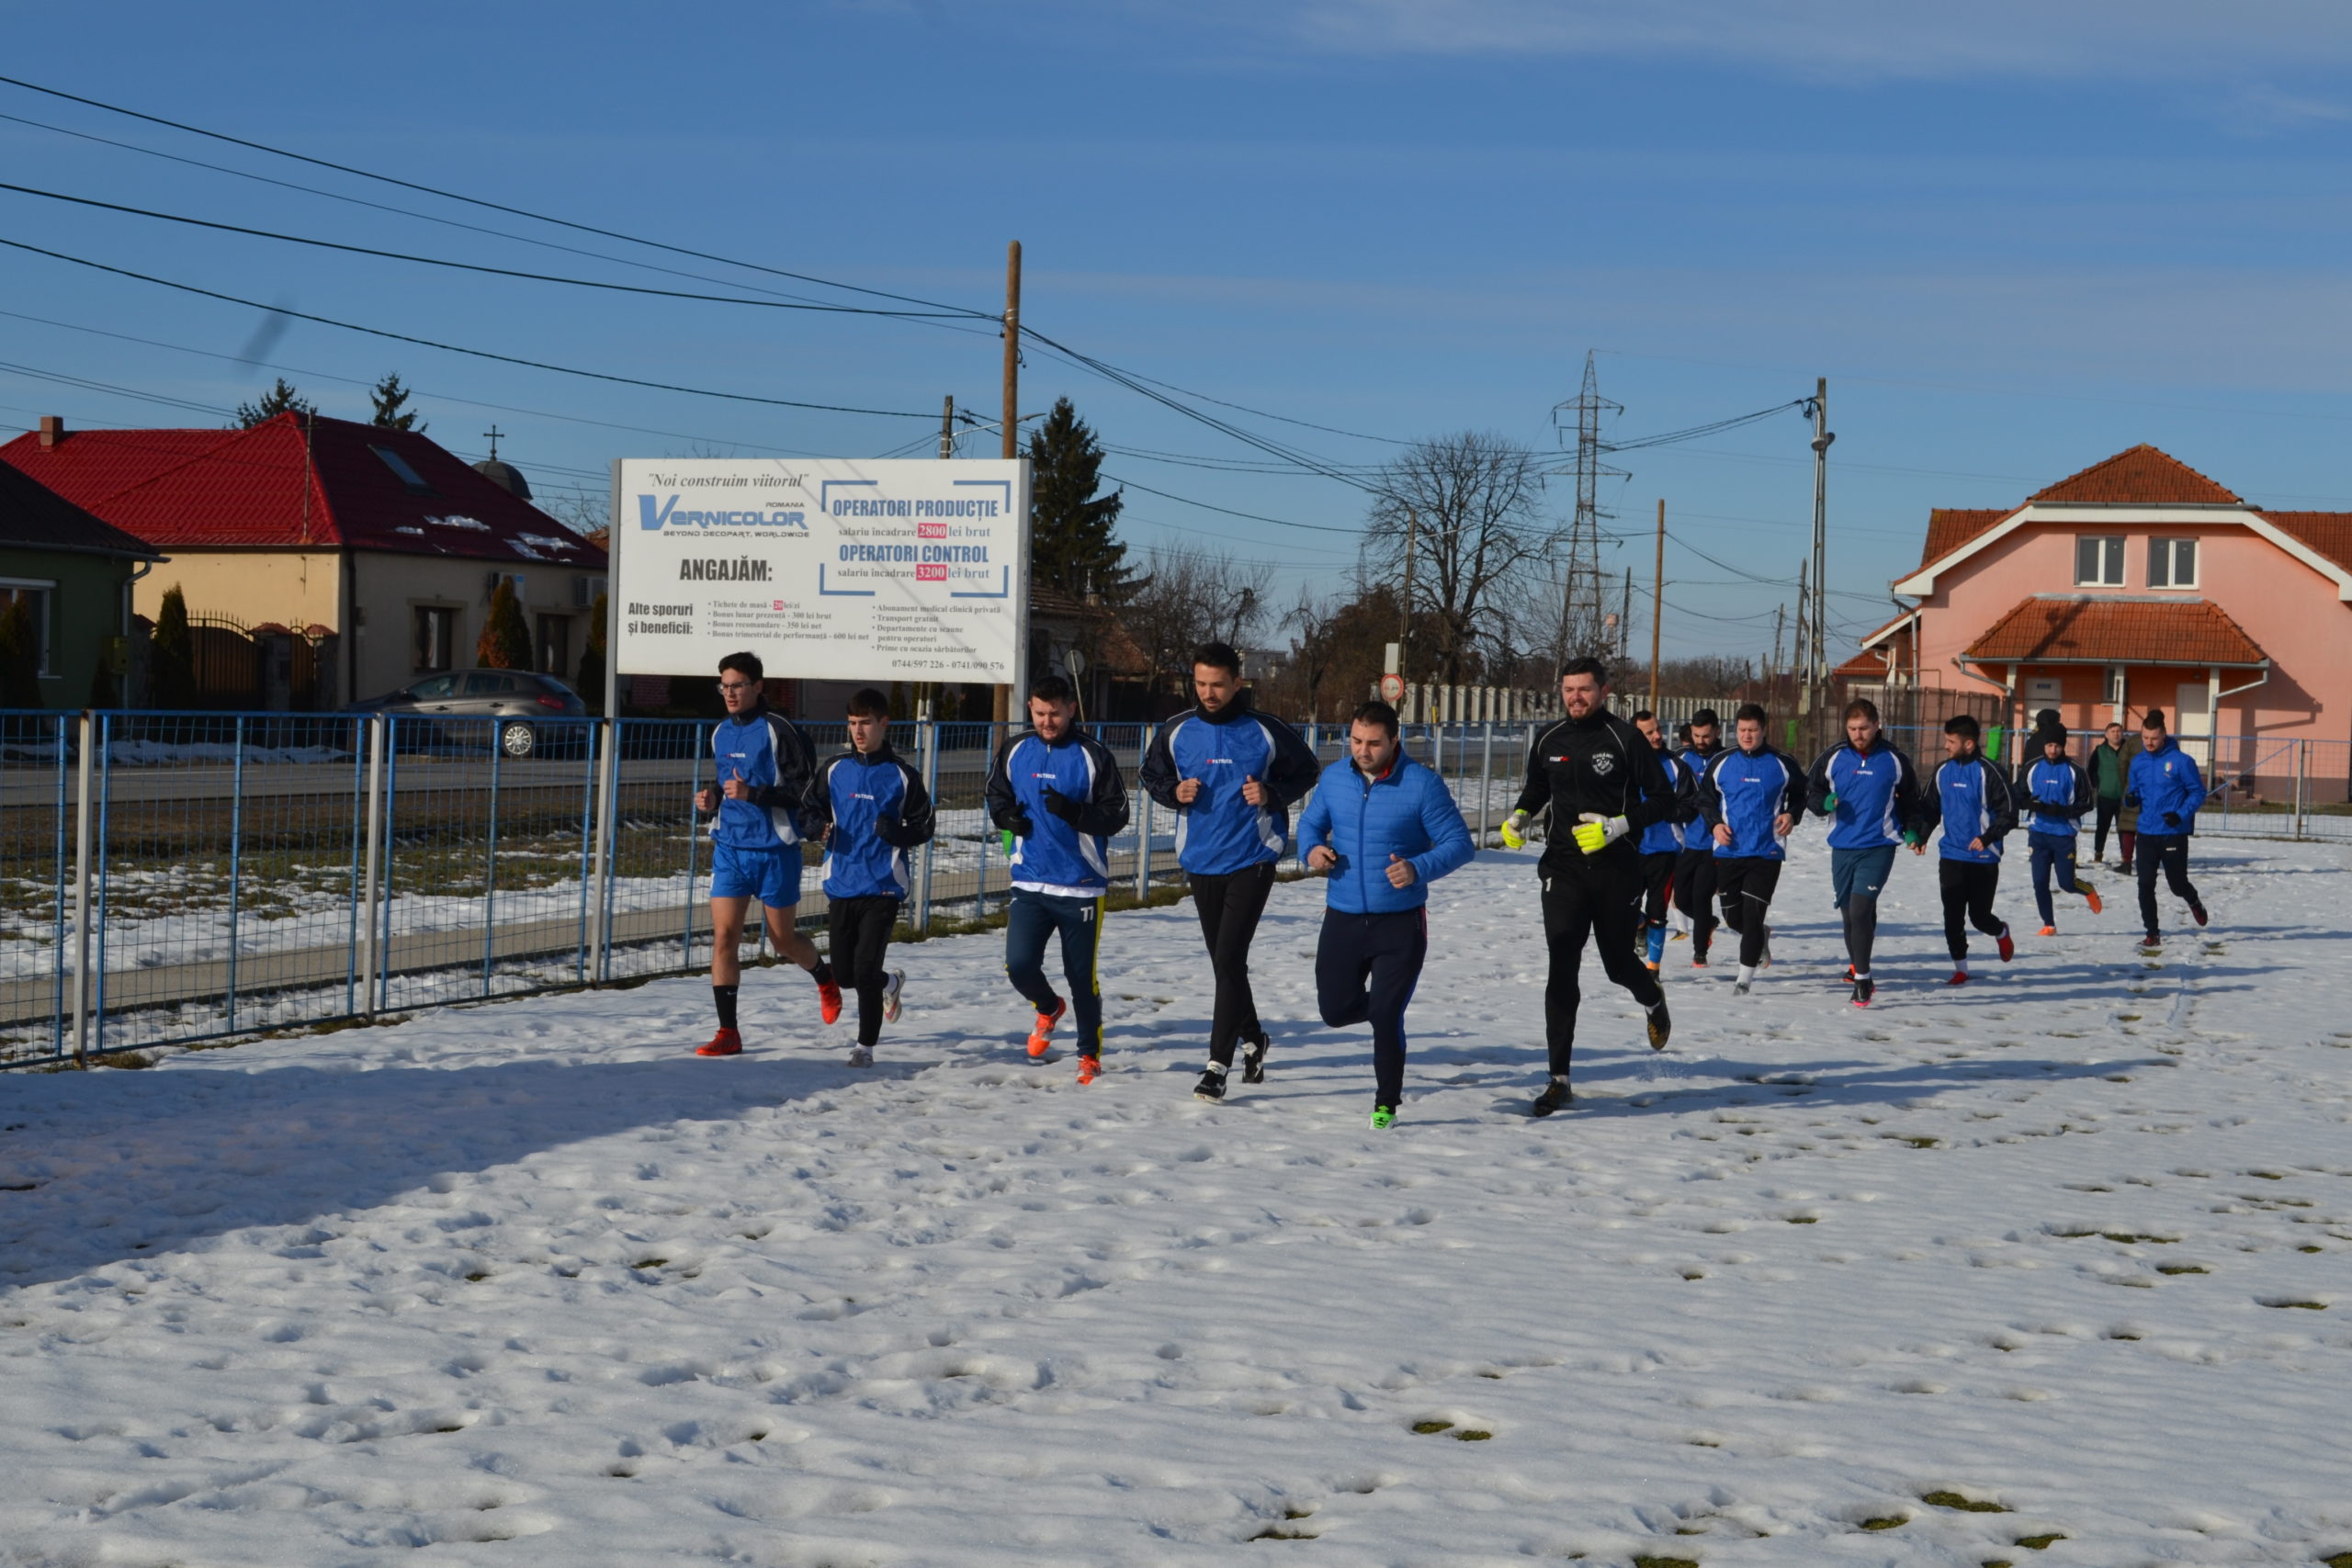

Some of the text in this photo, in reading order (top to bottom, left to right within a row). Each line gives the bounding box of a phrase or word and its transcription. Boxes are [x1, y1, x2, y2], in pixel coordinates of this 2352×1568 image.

[680, 474, 748, 487] construim
[832, 499, 912, 517] OPERATORI
[838, 527, 870, 536] salariu
[919, 525, 946, 537] 2800
[948, 526, 962, 537] lei
[966, 526, 990, 537] brut
[839, 545, 989, 563] OPERATORI CONTROL
[679, 554, 773, 581] ANGAJĂM:
[837, 568, 868, 577] salariu
[917, 567, 945, 579] 3200
[947, 568, 961, 578] lei
[965, 568, 990, 579] brut
[628, 602, 694, 616] Alte sporuri
[876, 604, 918, 613] Abonament
[920, 605, 948, 614] medical
[877, 614, 939, 623] Transport gratuit
[640, 620, 694, 635] beneficii:
[876, 625, 928, 633] Departamente
[847, 632, 856, 640] lei
[903, 635, 937, 643] operatori
[989, 661, 1005, 671] 576
